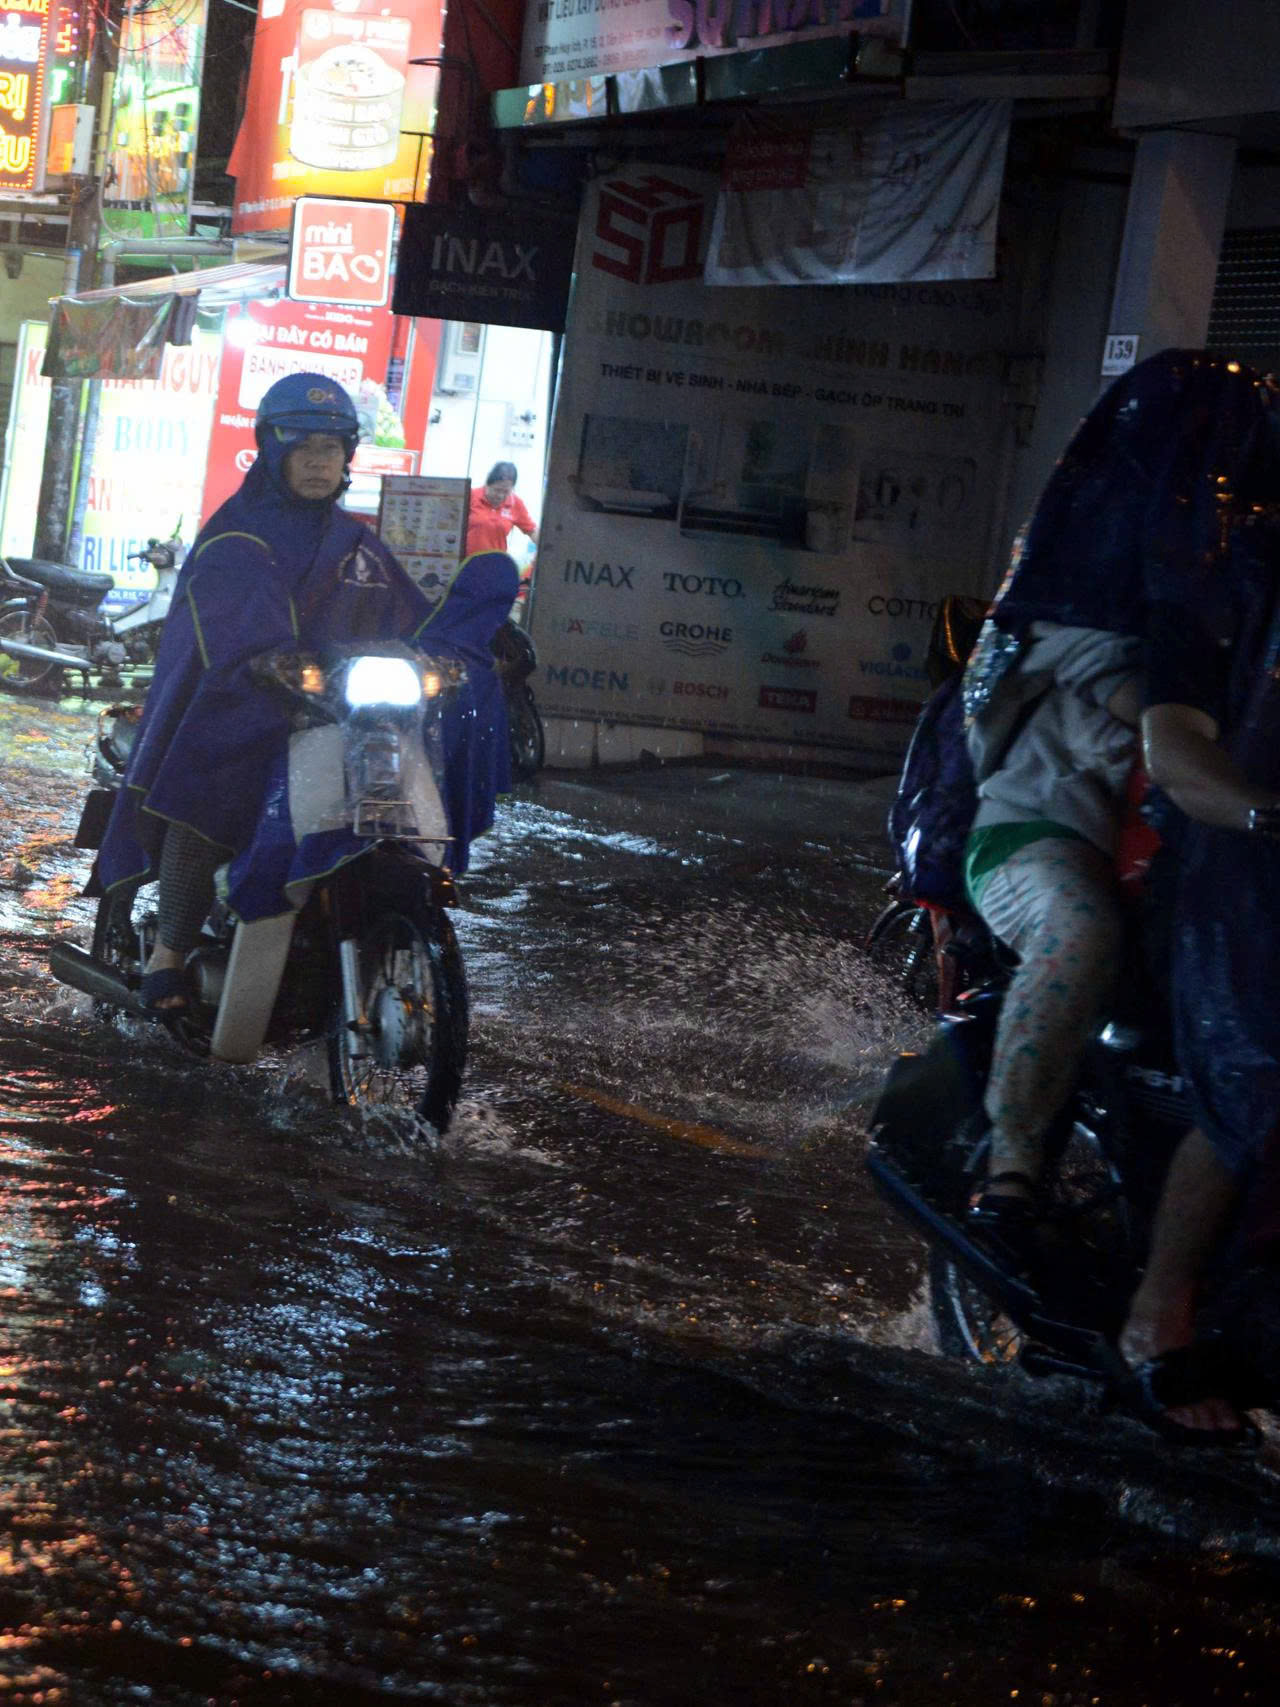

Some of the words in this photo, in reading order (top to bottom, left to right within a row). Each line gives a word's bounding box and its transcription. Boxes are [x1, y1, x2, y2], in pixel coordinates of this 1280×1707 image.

[304, 221, 353, 244] mini
[432, 235, 538, 280] INAX
[564, 560, 634, 590] INAX
[659, 620, 733, 642] GROHE
[546, 664, 629, 691] MOEN
[673, 681, 730, 699] BOSCH
